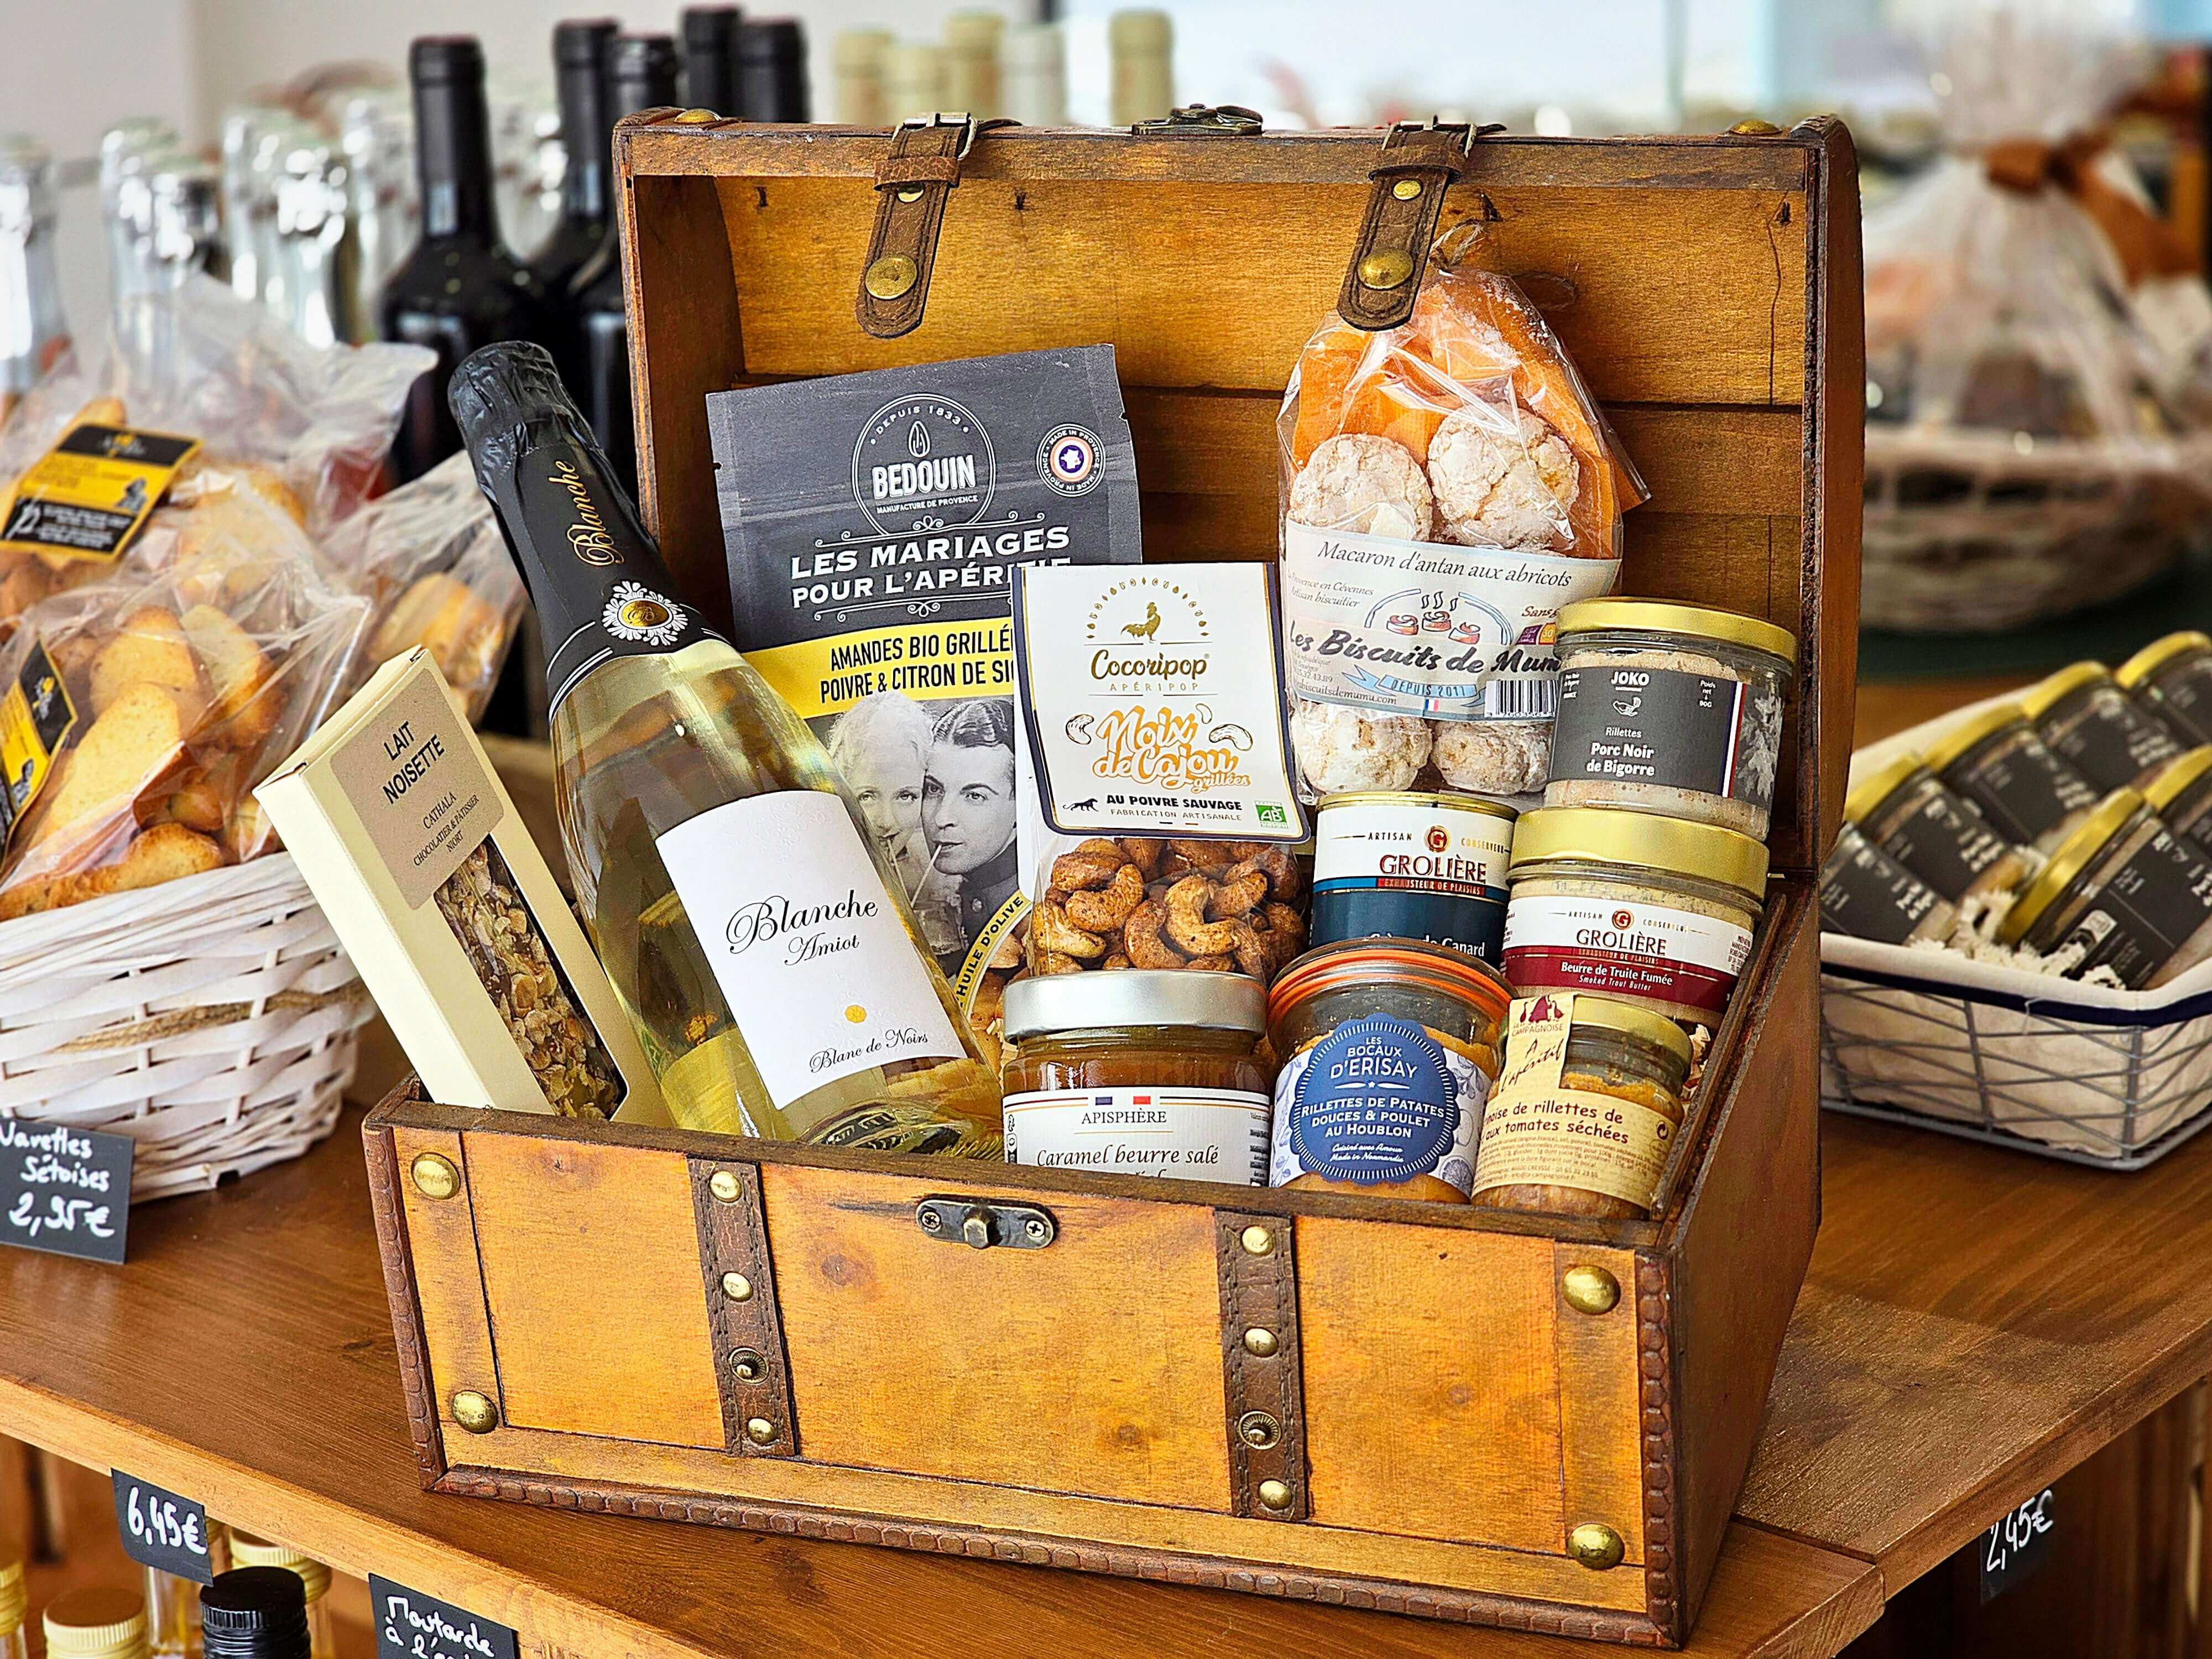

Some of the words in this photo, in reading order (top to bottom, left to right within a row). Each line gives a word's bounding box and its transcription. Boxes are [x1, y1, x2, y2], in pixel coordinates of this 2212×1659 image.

[875, 405, 921, 435] DEPUIS
[928, 405, 962, 425] 1833
[1048, 430, 1068, 445] MADE
[1079, 432, 1100, 469] PROVENCE
[872, 454, 977, 500] BEDOUIN
[548, 460, 625, 566] Blanche
[877, 502, 926, 514] MANUFACTURE
[926, 499, 936, 508] DE
[938, 495, 978, 507] PROVENCE
[791, 549, 858, 581] LES
[870, 526, 1070, 568] MARIAGES
[1317, 540, 1396, 570] Macaron
[1401, 551, 1465, 576] d'antan
[1468, 564, 1503, 580] aux
[1505, 562, 1573, 588] abricots
[792, 576, 874, 608] POUR
[885, 557, 1071, 594] L'APÉRI
[1315, 592, 1360, 608] biscuitier
[830, 637, 903, 672] AMANDES
[909, 634, 940, 659] BIO
[1317, 629, 1439, 672] Biscuits
[1446, 646, 1485, 675] de
[820, 672, 873, 703] POIVRE
[878, 672, 888, 692] &
[891, 663, 956, 690] CITRON
[963, 660, 987, 685] DE
[1110, 681, 1198, 692] APÉRIPOP
[1391, 676, 1433, 696] DEPUIS
[1610, 671, 1650, 686] JOKO
[383, 721, 415, 761] LAIT
[1095, 705, 1198, 752] Noix
[1605, 726, 1642, 739] Rillettes
[1590, 742, 1621, 757] Porc
[1623, 743, 1655, 760] Noir
[382, 734, 445, 805] NOISETTE
[1092, 748, 1131, 778] de
[1129, 744, 1239, 790] Cajou
[1586, 759, 1602, 773] de
[1603, 760, 1656, 778] Bigorre
[422, 791, 457, 830] CATHALA
[1107, 794, 1125, 805] AU
[1130, 795, 1179, 807] POIVRE
[1182, 798, 1243, 811] SAUVAGE
[1110, 808, 1177, 818] FABRICATION
[1182, 811, 1243, 821] ARTISANALE
[413, 824, 453, 867] CHOCOLATIER
[446, 830, 465, 853] NIORT
[1368, 832, 1412, 842] ARTISAN
[1379, 854, 1487, 885] GROLIÈRE
[1437, 880, 1448, 891] DE
[1449, 883, 1481, 895] PLAISIRS
[726, 889, 878, 954] Blanche
[1568, 911, 1603, 920] ARTISAN
[784, 932, 859, 966] Amiot
[956, 950, 984, 1008] 'HUILE
[982, 895, 1025, 947] D'OLIVE
[1575, 928, 1667, 956] GROLIÈRE
[1619, 952, 1629, 961] DE
[1561, 961, 1594, 975] Beurre
[1595, 963, 1608, 976] de
[1609, 966, 1638, 980] Truite
[1641, 970, 1673, 986] Fumée
[1578, 974, 1606, 986] Smoked
[1608, 977, 1628, 988] Trout
[1629, 980, 1652, 992] Butter
[1365, 1037, 1383, 1045] LES
[1511, 1023, 1564, 1037] CAMPAGNOISE
[809, 1047, 863, 1074] Blanc
[865, 1037, 882, 1055] de
[885, 1027, 929, 1048] Noirs
[1347, 1045, 1402, 1058] BOCAUX
[1525, 1037, 1538, 1058] A
[1330, 1057, 1418, 1079] D'ERISAY
[1081, 1108, 1167, 1125] APISPHÈRE
[1301, 1097, 1363, 1119] RILLETTES
[1367, 1098, 1386, 1108] DE
[1389, 1097, 1445, 1119] PATATES
[1312, 1112, 1361, 1128] DOUCES
[1365, 1110, 1376, 1121] &
[1380, 1112, 1431, 1128] POULET
[1513, 1101, 1528, 1116] de
[1533, 1099, 1598, 1119] rillettes
[1604, 1109, 1624, 1125] de
[1325, 1126, 1343, 1139] AU
[1346, 1124, 1413, 1139] HOUBLON
[1485, 1125, 1501, 1140] aux
[1505, 1117, 1559, 1135] tomates
[1566, 1119, 1630, 1144] séchées
[1037, 1144, 1114, 1167] Caramel
[1114, 1144, 1180, 1165] beurre
[1185, 1144, 1219, 1165] salé
[20, 1154, 110, 1192] Sétoises
[8, 1191, 115, 1238] 2,95€
[127, 1486, 207, 1556] 6,45€
[384, 1615, 405, 1646] à
[387, 1595, 495, 1658] Moutarde
